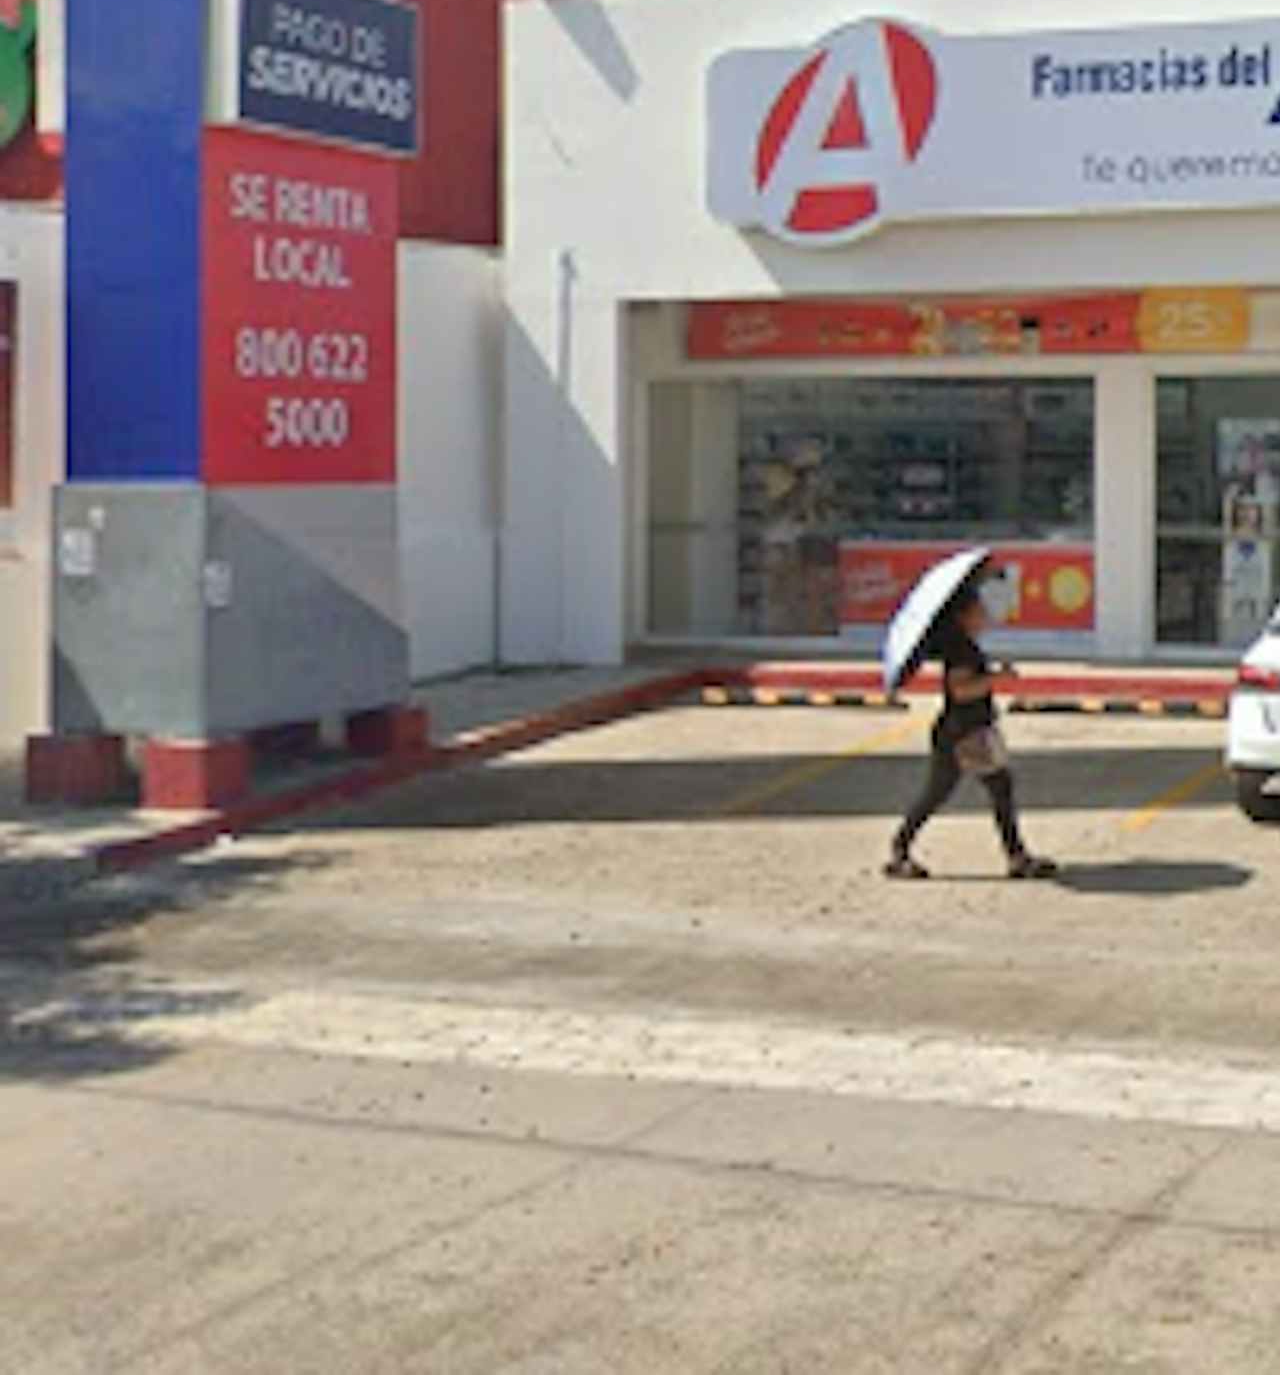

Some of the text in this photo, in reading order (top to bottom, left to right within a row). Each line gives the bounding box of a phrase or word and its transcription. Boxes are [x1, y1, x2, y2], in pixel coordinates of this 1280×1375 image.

[271, 1, 388, 70] PAGO DE
[250, 45, 412, 121] SERVICIOS
[1031, 54, 1207, 99] Farmacias
[1218, 42, 1270, 88] del
[754, 17, 938, 235] A
[230, 174, 374, 237] SE RENTA
[254, 235, 352, 290] LOCAL
[236, 324, 369, 383] 800 622
[263, 395, 349, 449] 5000
